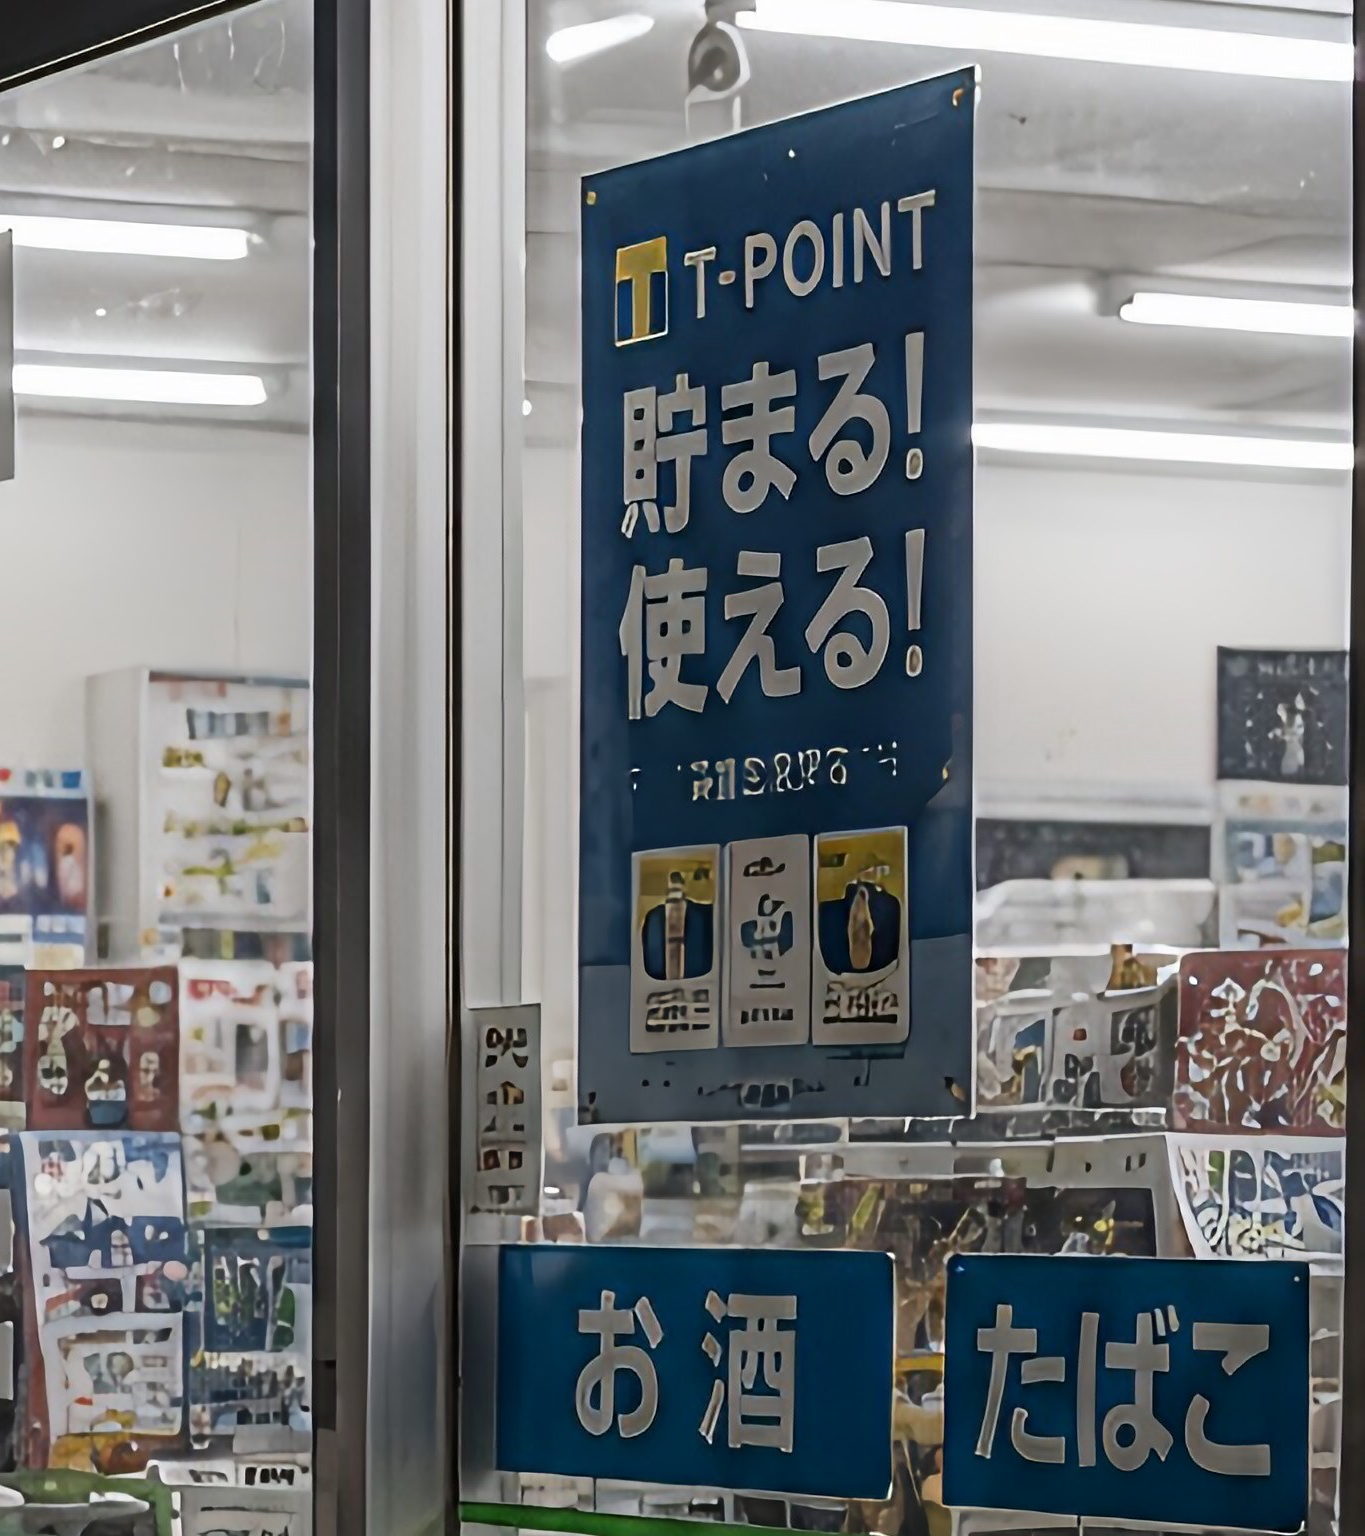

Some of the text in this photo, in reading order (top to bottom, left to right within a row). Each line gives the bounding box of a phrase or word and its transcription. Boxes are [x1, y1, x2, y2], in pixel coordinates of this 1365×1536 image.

[682, 189, 938, 321] T-POINT
[619, 331, 928, 541] 貯まる!
[617, 529, 927, 722] 使える!
[974, 1302, 1272, 1478] たばこ
